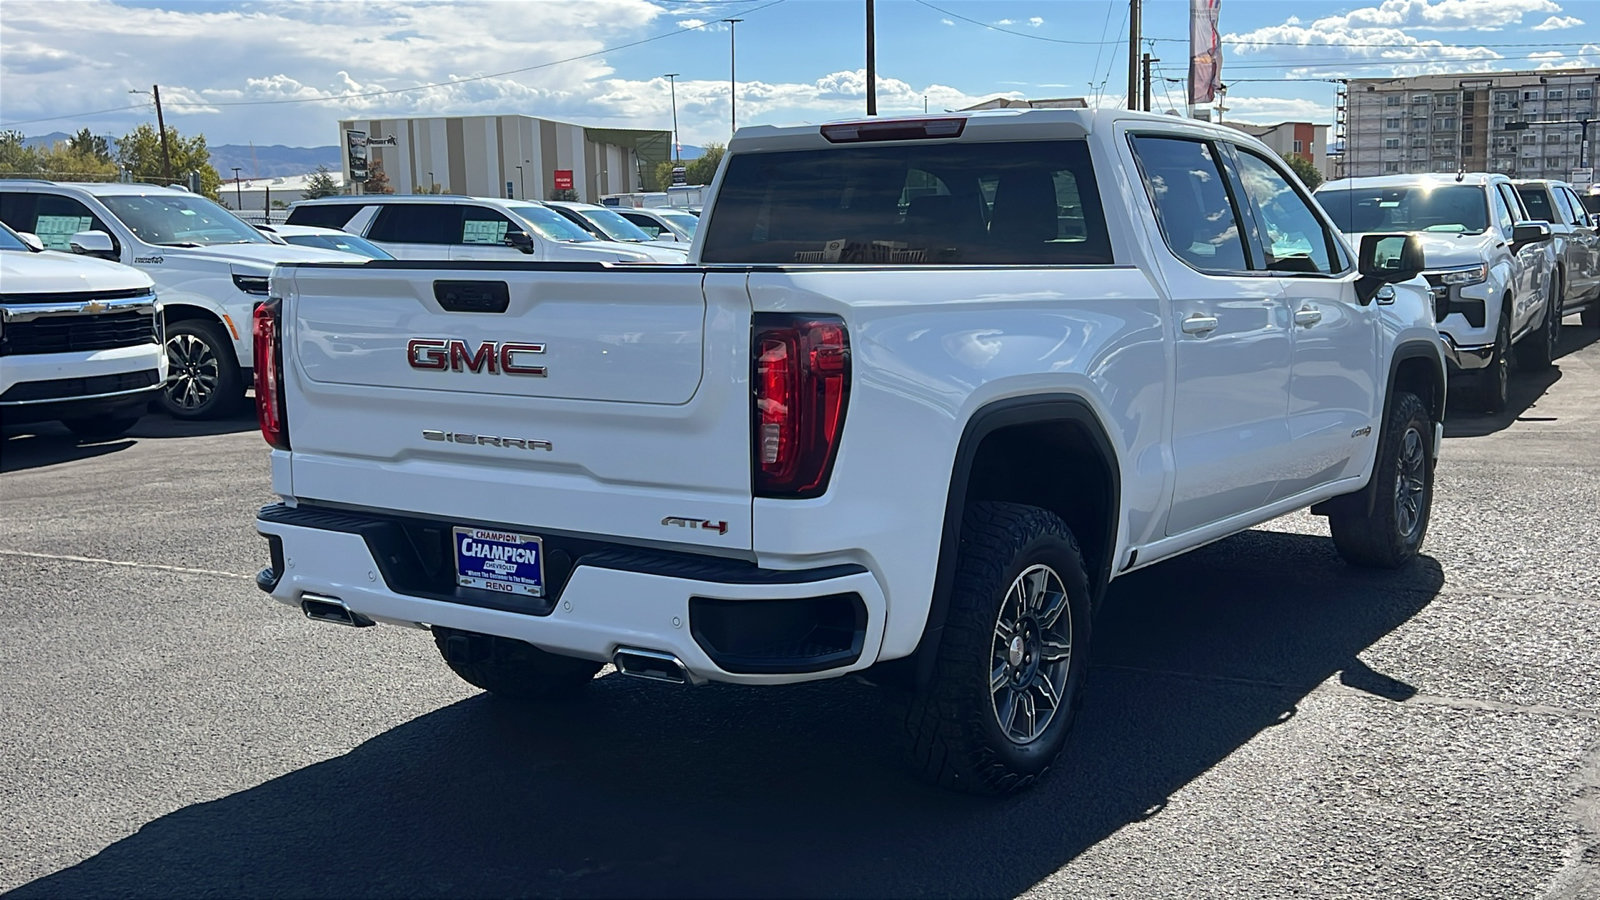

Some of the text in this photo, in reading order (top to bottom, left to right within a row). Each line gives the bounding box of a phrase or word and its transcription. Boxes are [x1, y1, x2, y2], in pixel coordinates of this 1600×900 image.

[407, 338, 547, 377] GMC
[422, 429, 553, 452] SIERRA
[661, 516, 728, 535] AT4
[476, 531, 516, 542] CHAMPION
[462, 538, 536, 564] CHAMPION
[486, 562, 515, 571] CHEVROLET
[486, 582, 513, 591] RENO
